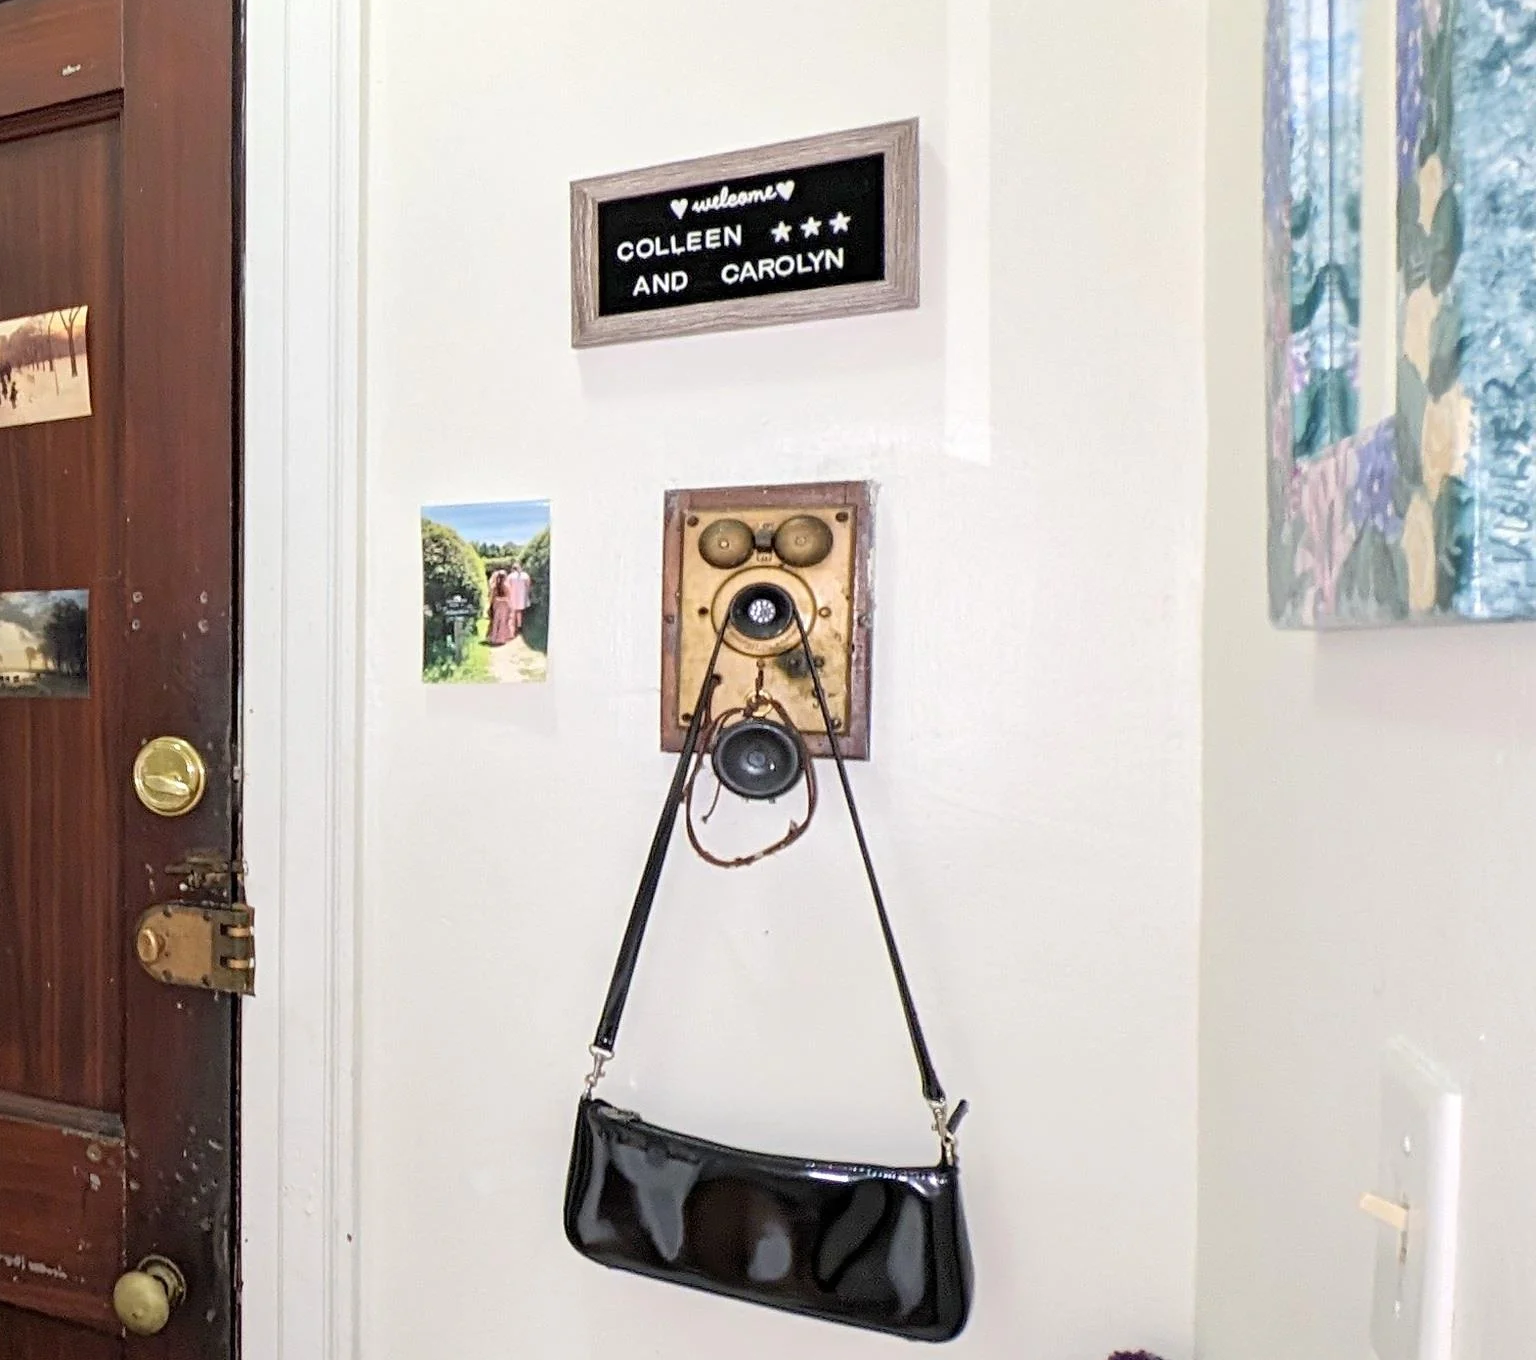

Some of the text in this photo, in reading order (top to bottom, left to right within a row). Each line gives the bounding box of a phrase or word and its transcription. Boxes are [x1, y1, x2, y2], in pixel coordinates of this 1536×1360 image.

[691, 184, 778, 214] welcome
[615, 223, 743, 263] COLLEEN
[632, 247, 845, 297] AND CAROLYN
